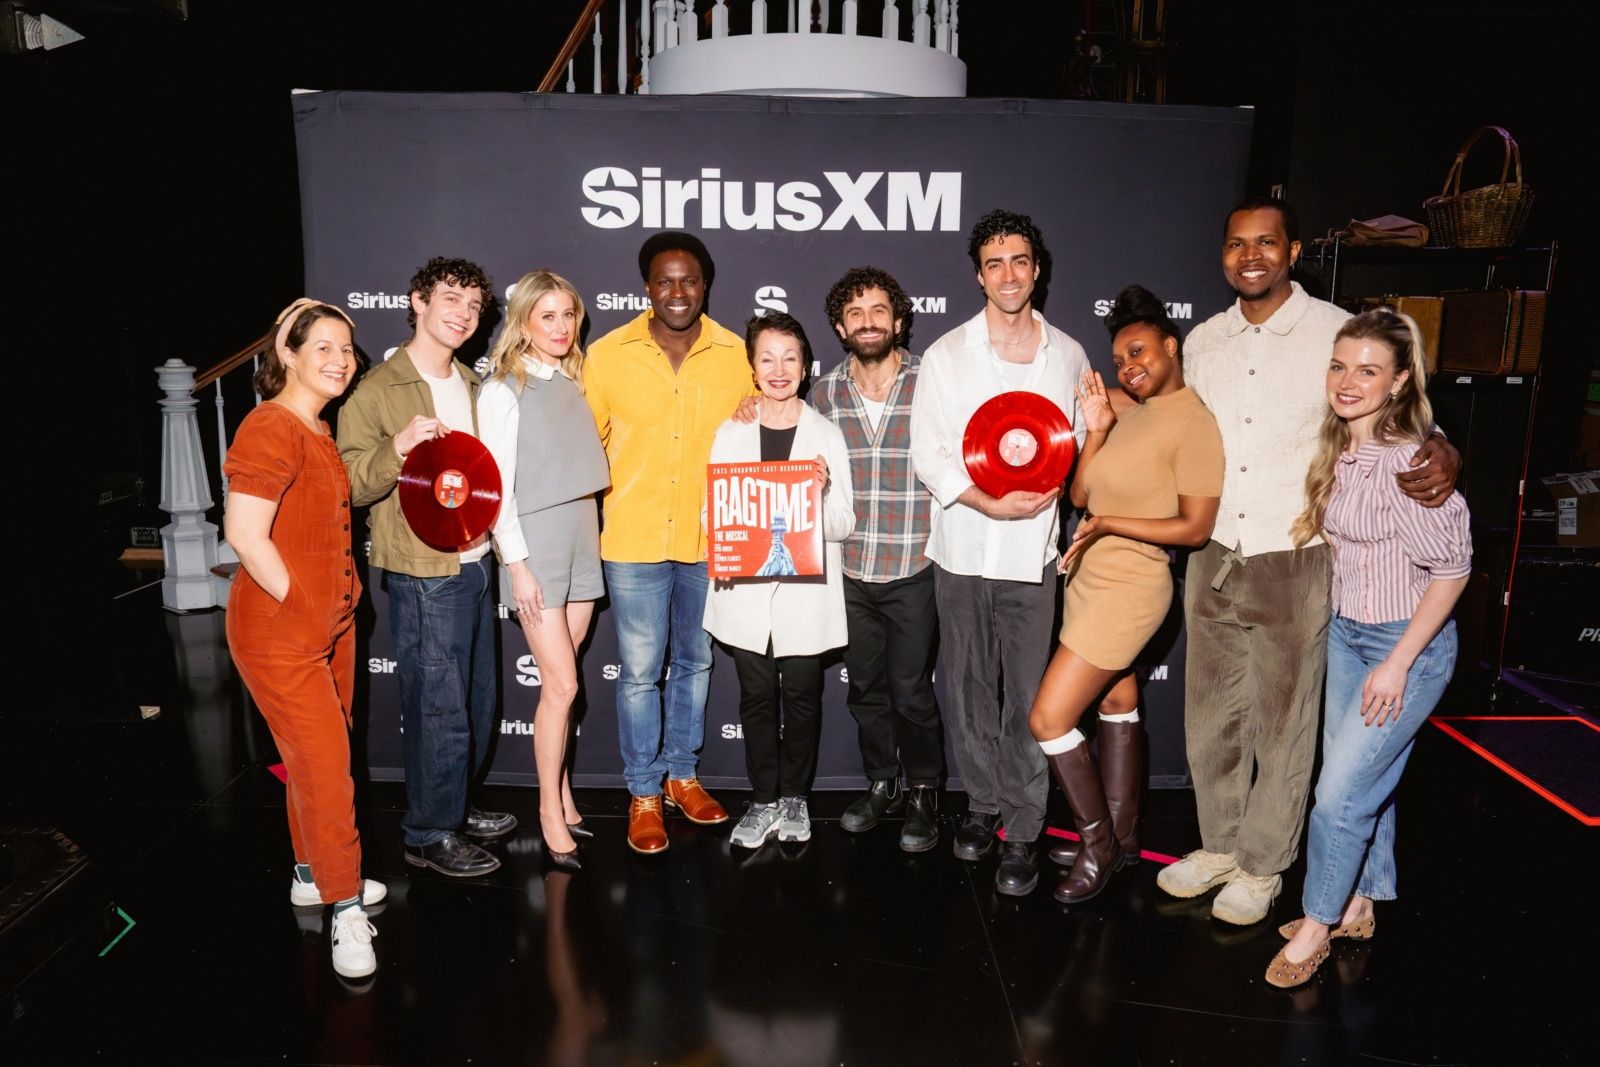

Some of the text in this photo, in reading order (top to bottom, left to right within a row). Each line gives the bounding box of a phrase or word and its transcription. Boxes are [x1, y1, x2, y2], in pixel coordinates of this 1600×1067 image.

[581, 166, 962, 231] SiriusXM
[347, 292, 410, 309] Sirius
[763, 465, 777, 473] CAST
[780, 464, 813, 472] RECORDING
[713, 476, 814, 533] RAGTIME
[714, 530, 749, 542] THE MUSICAL
